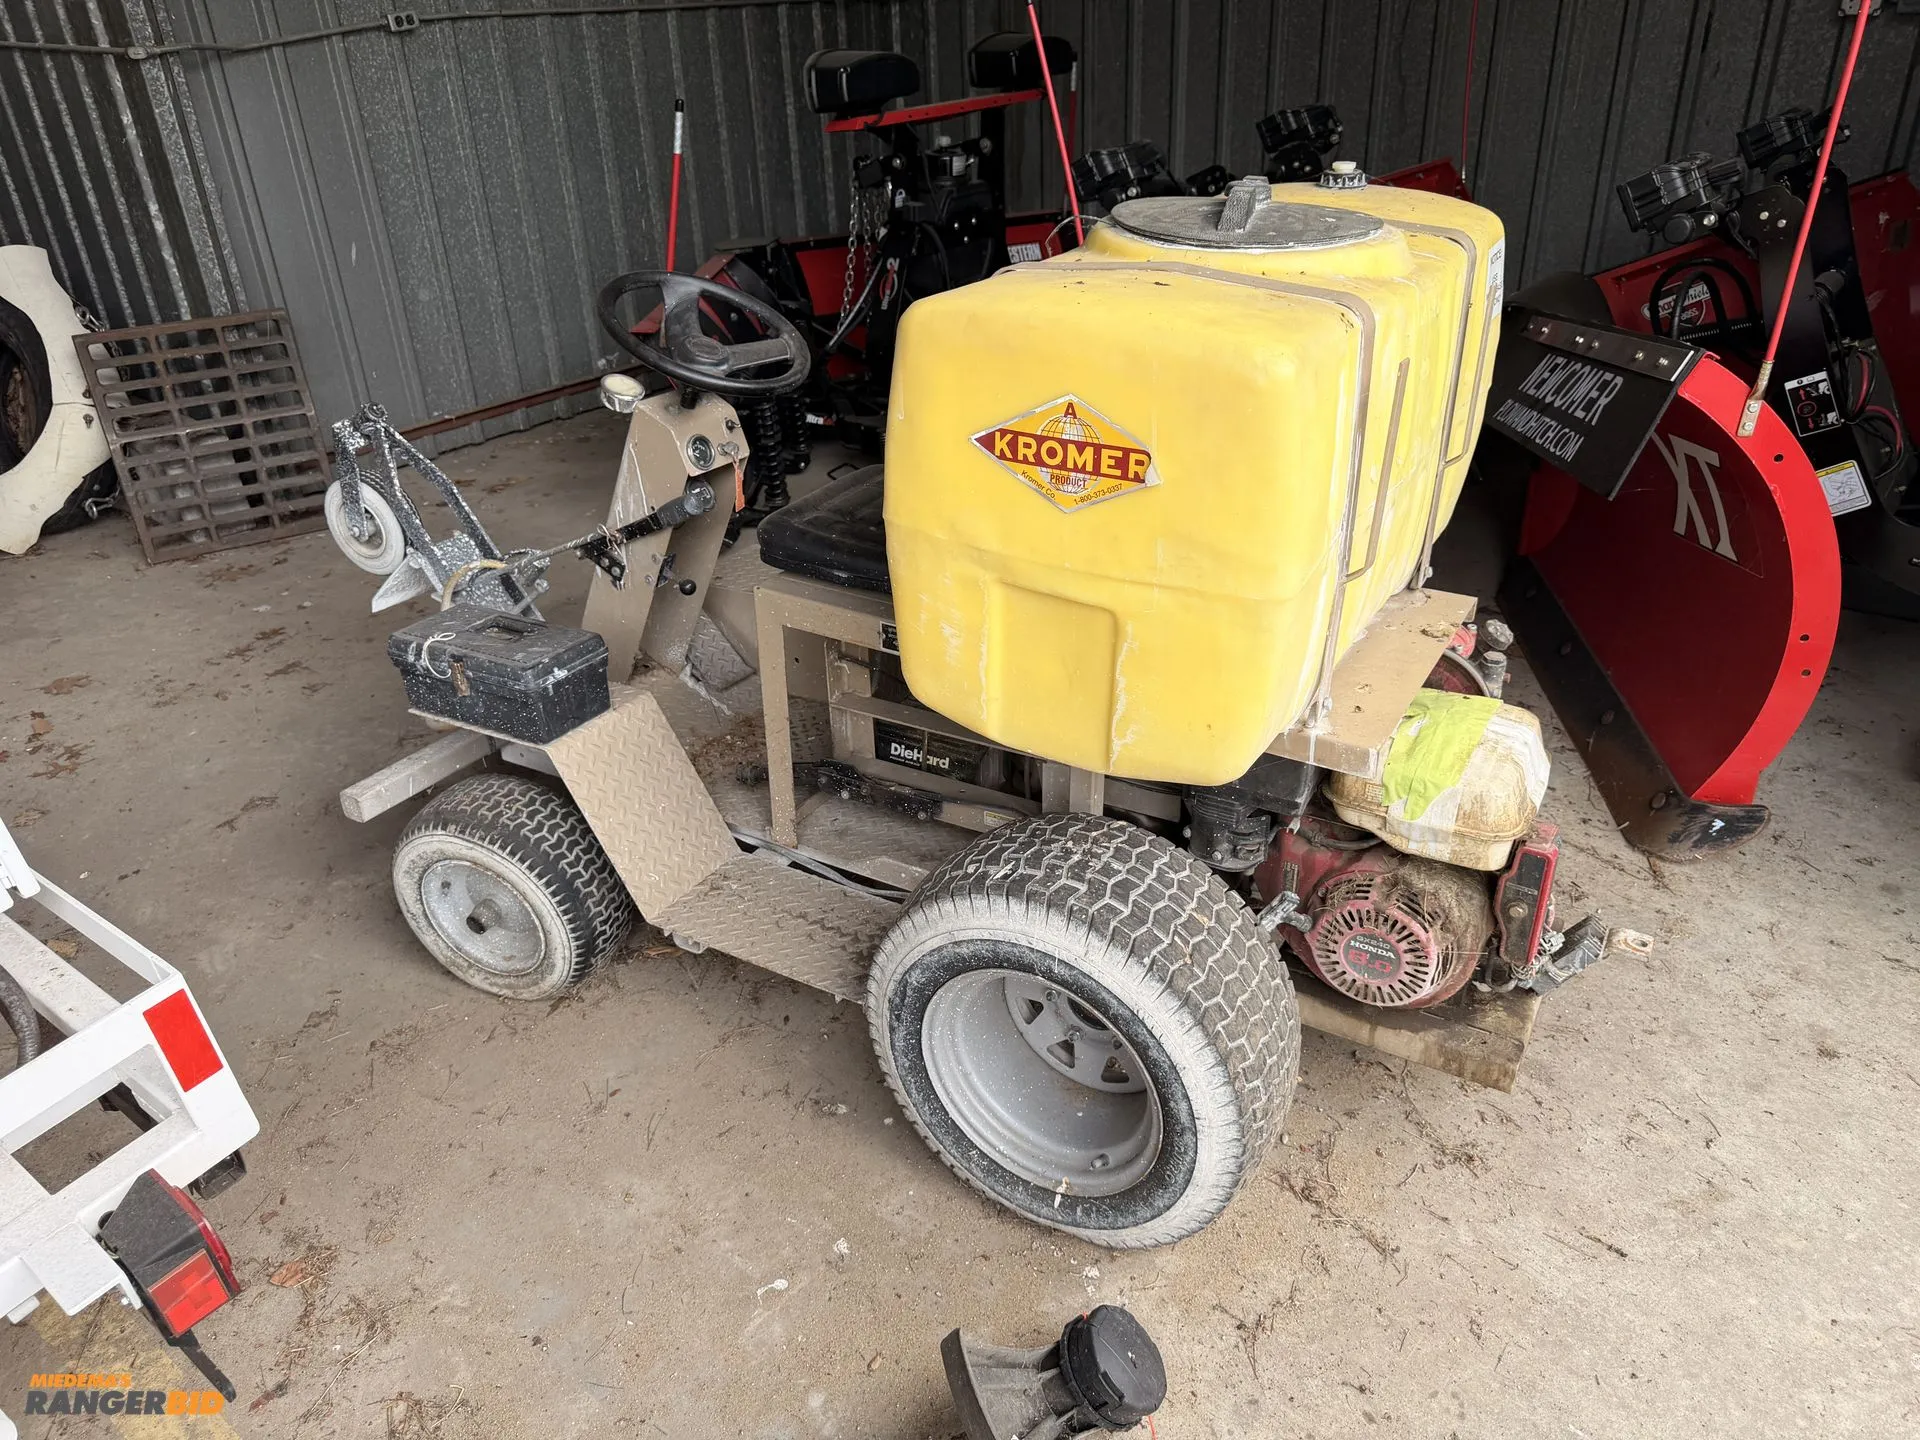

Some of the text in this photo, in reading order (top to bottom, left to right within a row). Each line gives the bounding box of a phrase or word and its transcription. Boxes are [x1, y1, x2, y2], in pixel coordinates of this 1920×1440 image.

[1007, 242, 1042, 264] ESTERN
[1518, 353, 1624, 426] NEWCOMER
[1063, 402, 1077, 419] A
[994, 431, 1151, 480] KROMER
[1021, 470, 1045, 490] Kromer
[1050, 474, 1087, 488] PRODUCT
[891, 742, 950, 769] DieHard
[1350, 940, 1396, 959] HONDA
